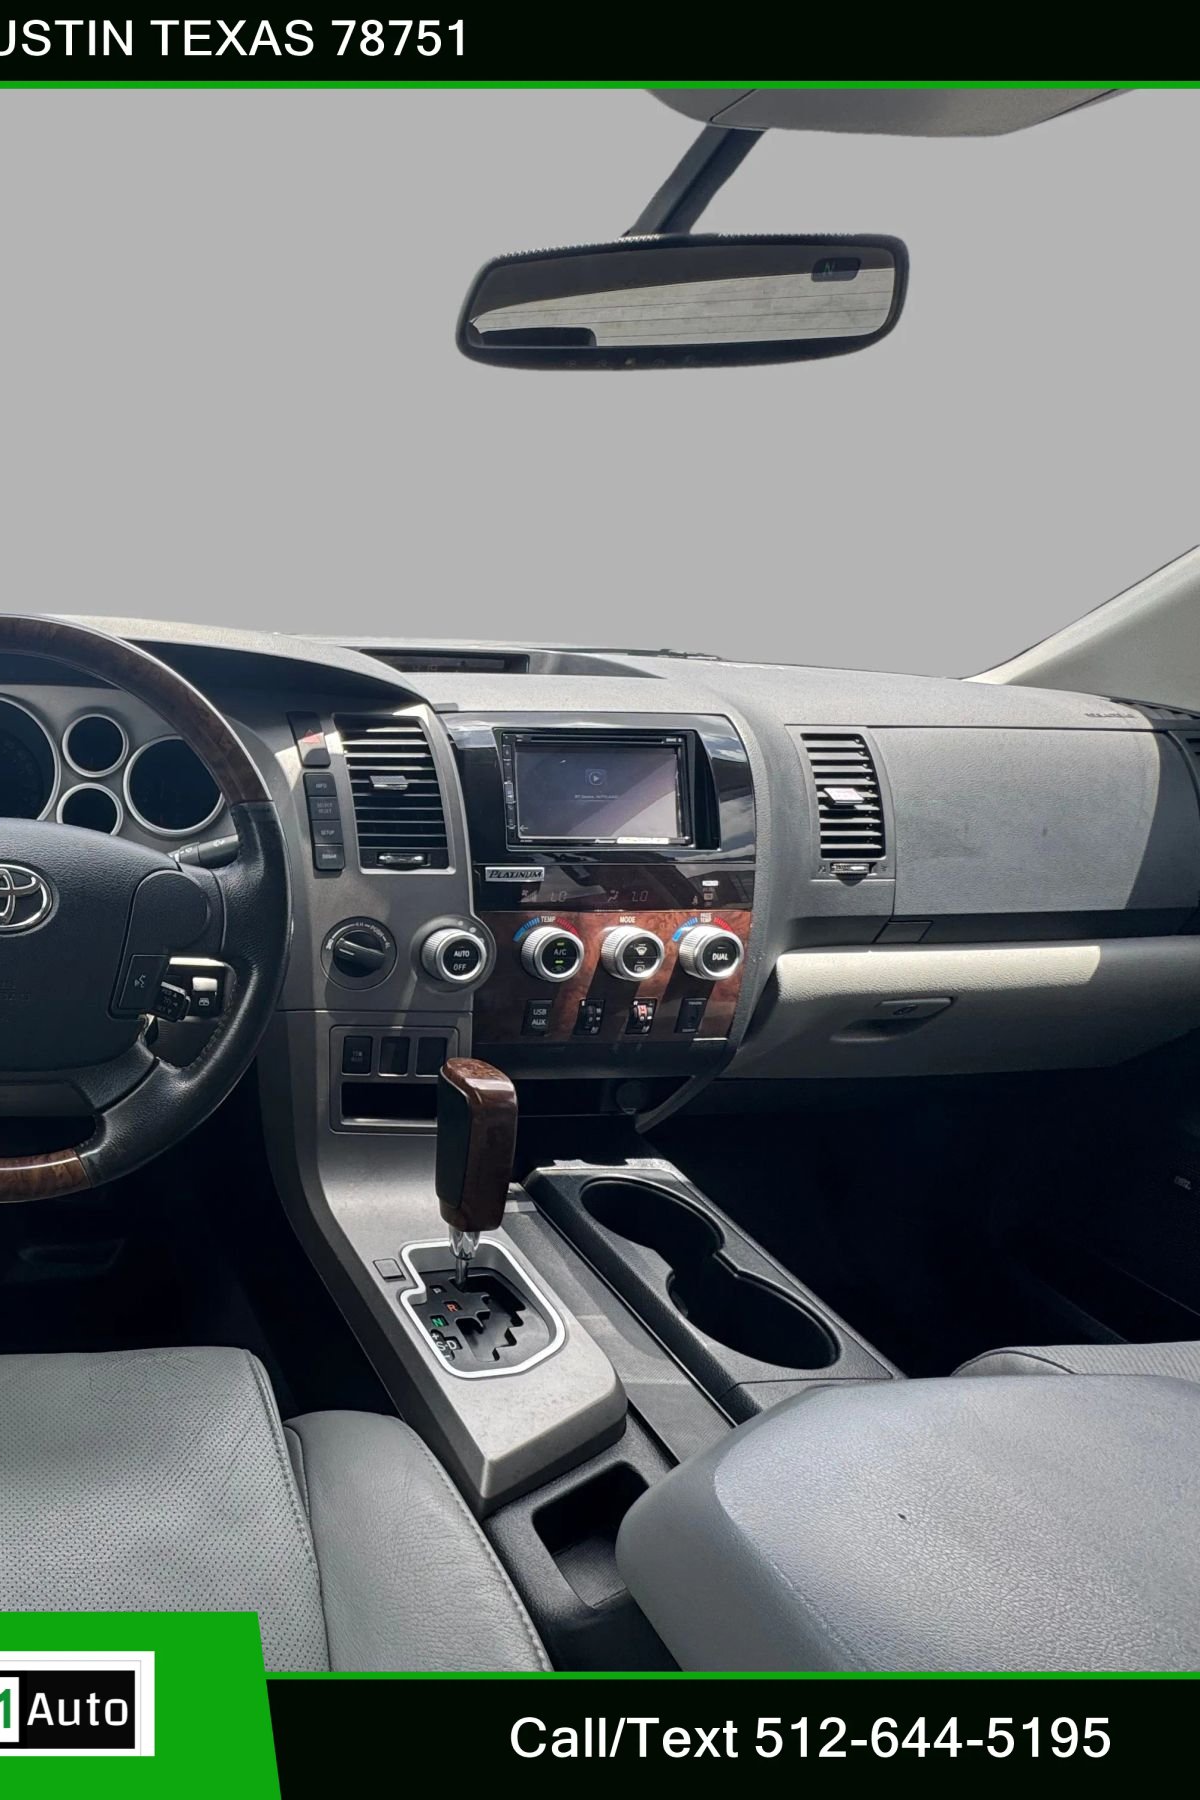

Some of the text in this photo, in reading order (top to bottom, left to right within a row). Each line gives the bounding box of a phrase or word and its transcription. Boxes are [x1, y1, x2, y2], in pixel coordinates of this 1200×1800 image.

[453, 950, 470, 958] AUTO
[554, 948, 567, 956] A/C
[711, 952, 729, 961] DUAL
[453, 963, 467, 971] OFF
[533, 1008, 547, 1016] USB
[531, 1018, 547, 1026] AUX
[432, 1318, 443, 1326] N
[446, 1340, 457, 1351] D
